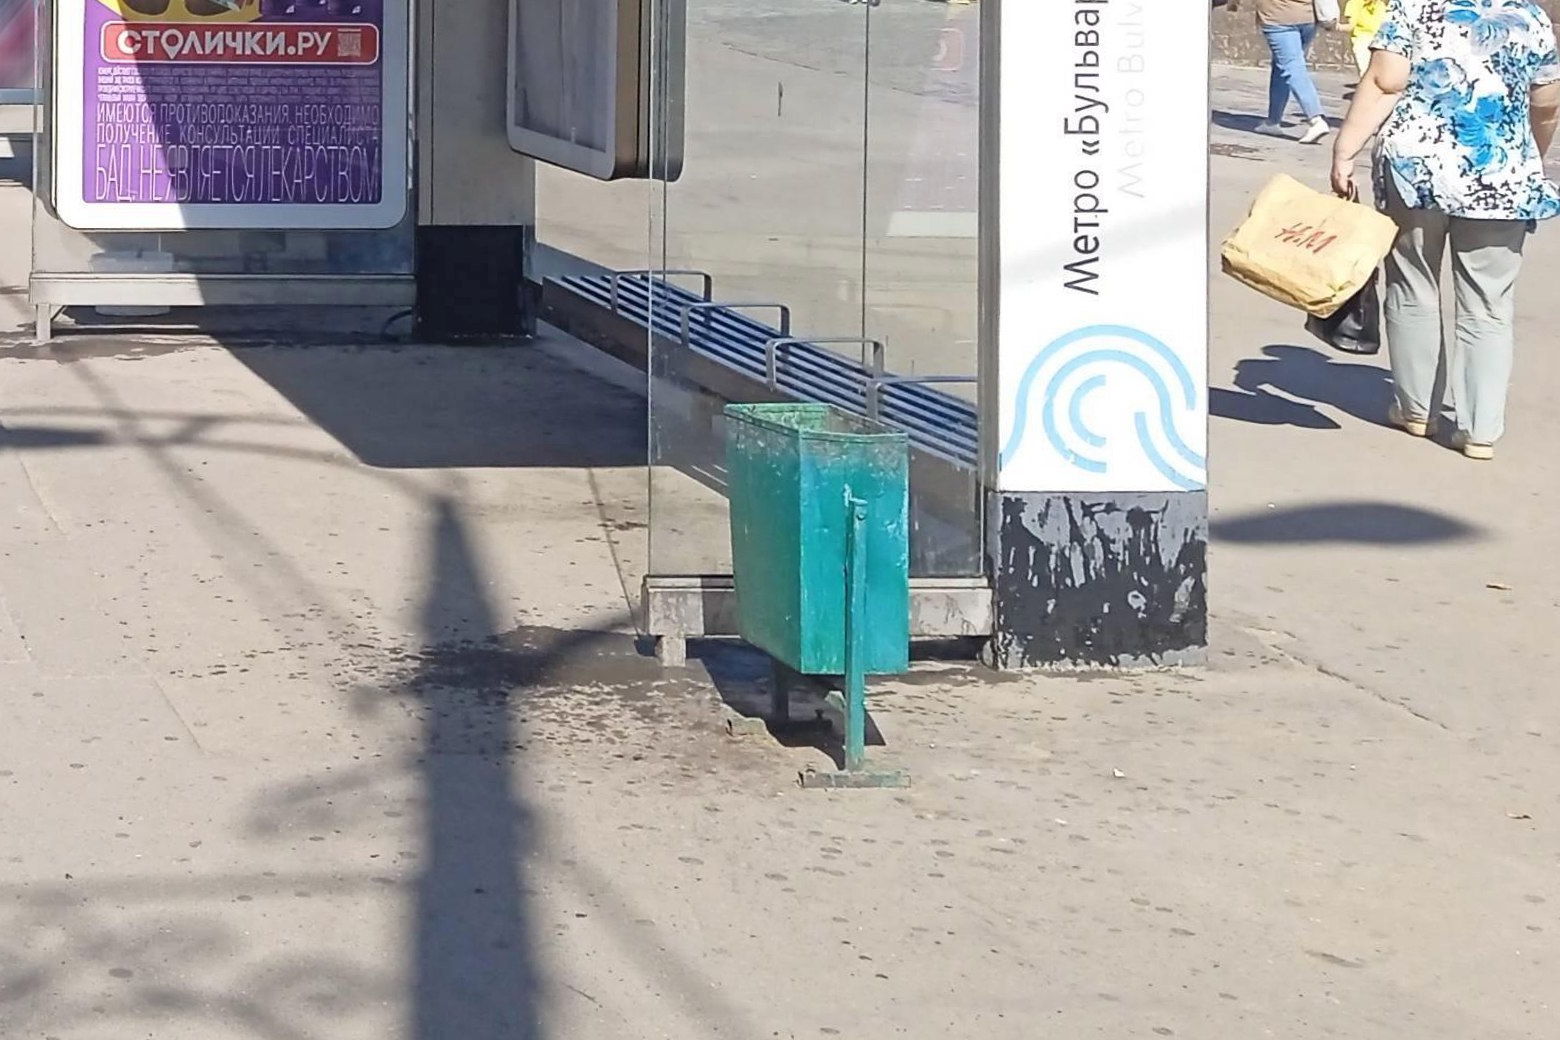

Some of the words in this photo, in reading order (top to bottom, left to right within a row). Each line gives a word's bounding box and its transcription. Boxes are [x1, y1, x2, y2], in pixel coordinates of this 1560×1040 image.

[116, 28, 332, 60] СТОЛИЧКИ.РУ
[96, 102, 156, 124] ИМЕЮТСЯ
[295, 104, 379, 125] НЕОБХОДИМО
[96, 123, 171, 144] ПОЛУЧЕНИЕ
[180, 124, 280, 145] КОНСУЛЬТАЦИИ
[1116, 88, 1146, 198] Metro
[140, 144, 163, 202] НЕ
[165, 144, 255, 202] ЯВЛЯЕТСЯ
[258, 145, 379, 203] ЛЕКАРСТВОМ
[1062, 169, 1109, 296] Метро
